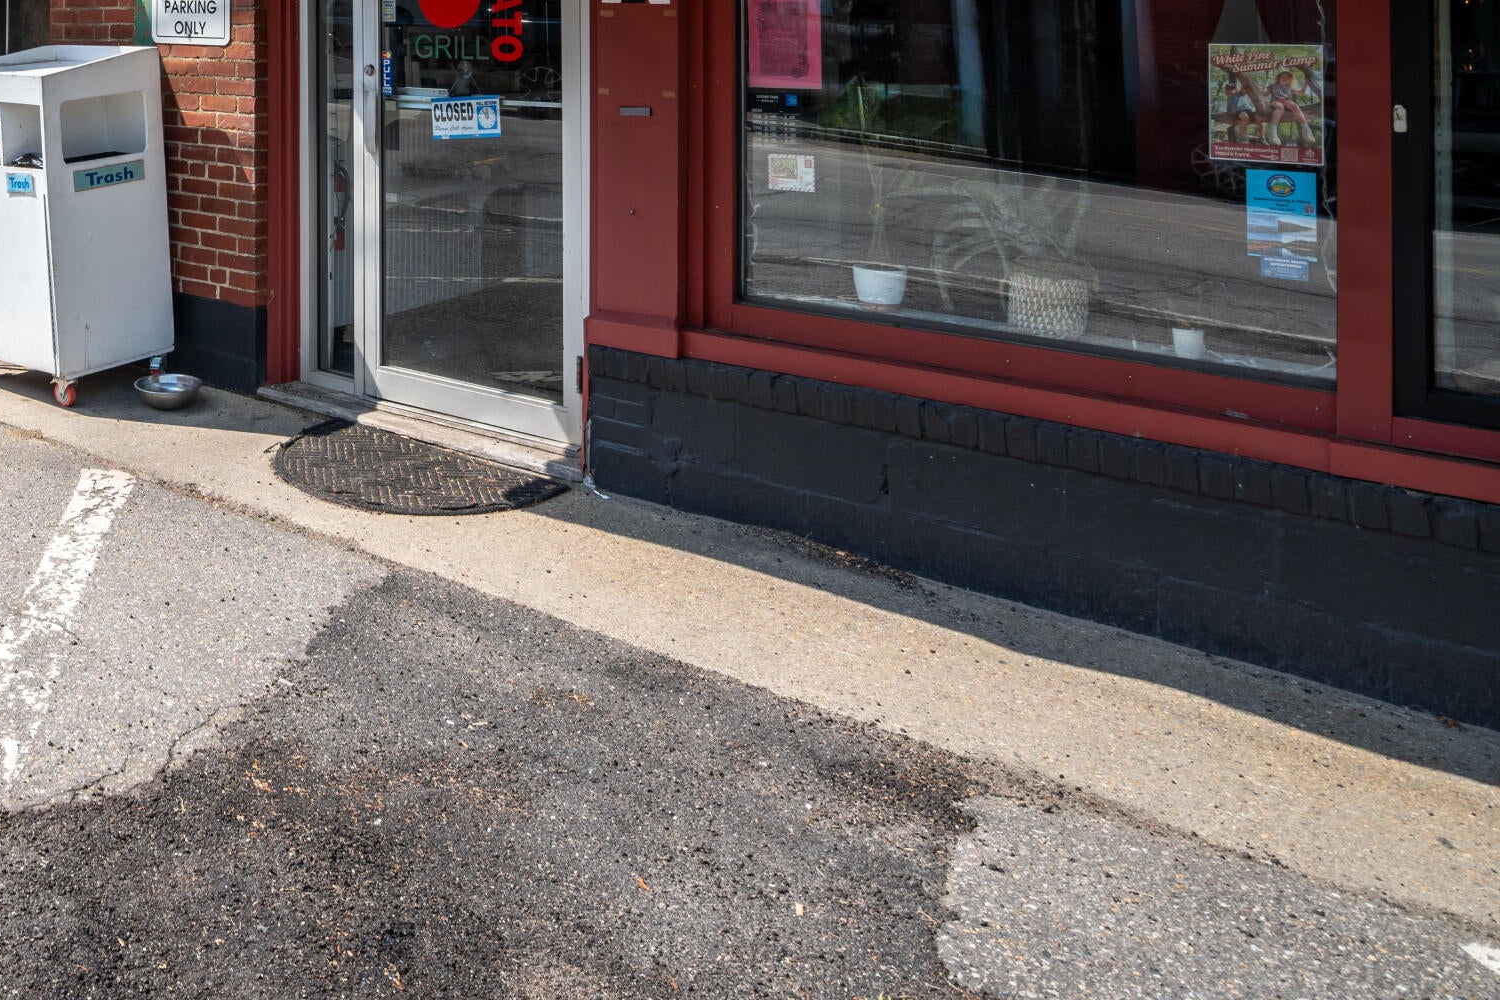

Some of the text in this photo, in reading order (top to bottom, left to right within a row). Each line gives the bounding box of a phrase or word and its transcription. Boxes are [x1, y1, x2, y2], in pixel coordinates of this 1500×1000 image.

[164, 0, 217, 15] PARKING
[174, 20, 207, 35] ONLY
[414, 34, 490, 60] GRILL
[1213, 53, 1246, 65] White
[1232, 56, 1316, 73] Summer Camp
[382, 59, 391, 87] PULL
[433, 101, 474, 123] CLOSED
[9, 177, 30, 190] Trash
[85, 167, 134, 187] Trash
